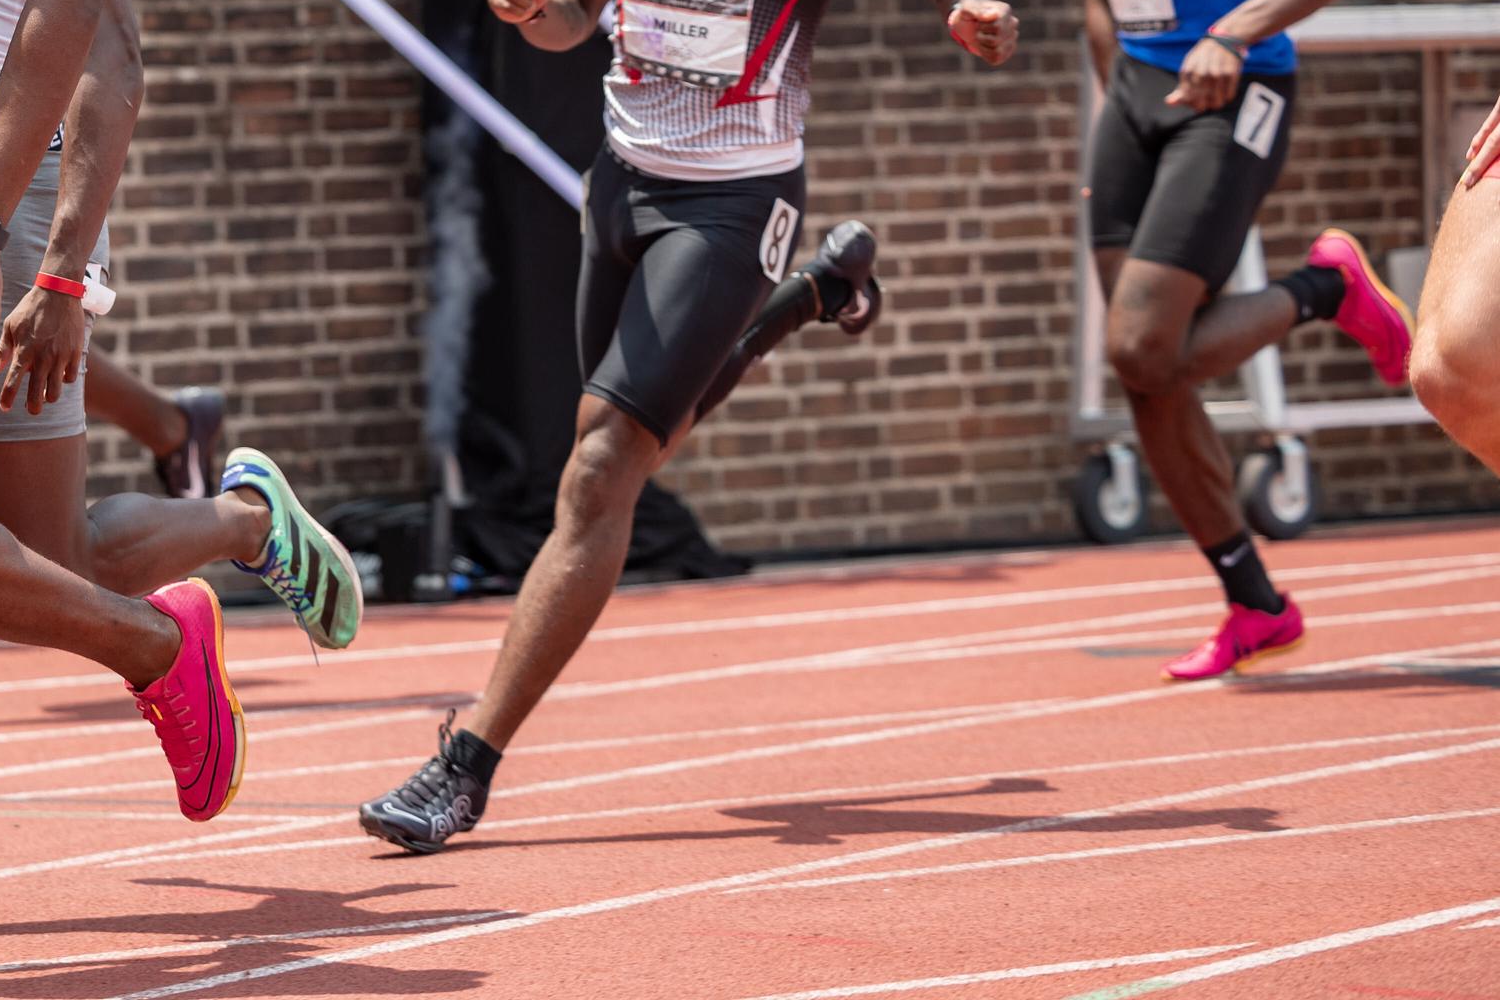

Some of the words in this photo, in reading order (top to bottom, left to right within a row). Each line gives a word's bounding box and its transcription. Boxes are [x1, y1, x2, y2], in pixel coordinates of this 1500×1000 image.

[652, 17, 709, 40] MILLER
[1248, 93, 1274, 142] 7
[766, 208, 790, 273] 8
